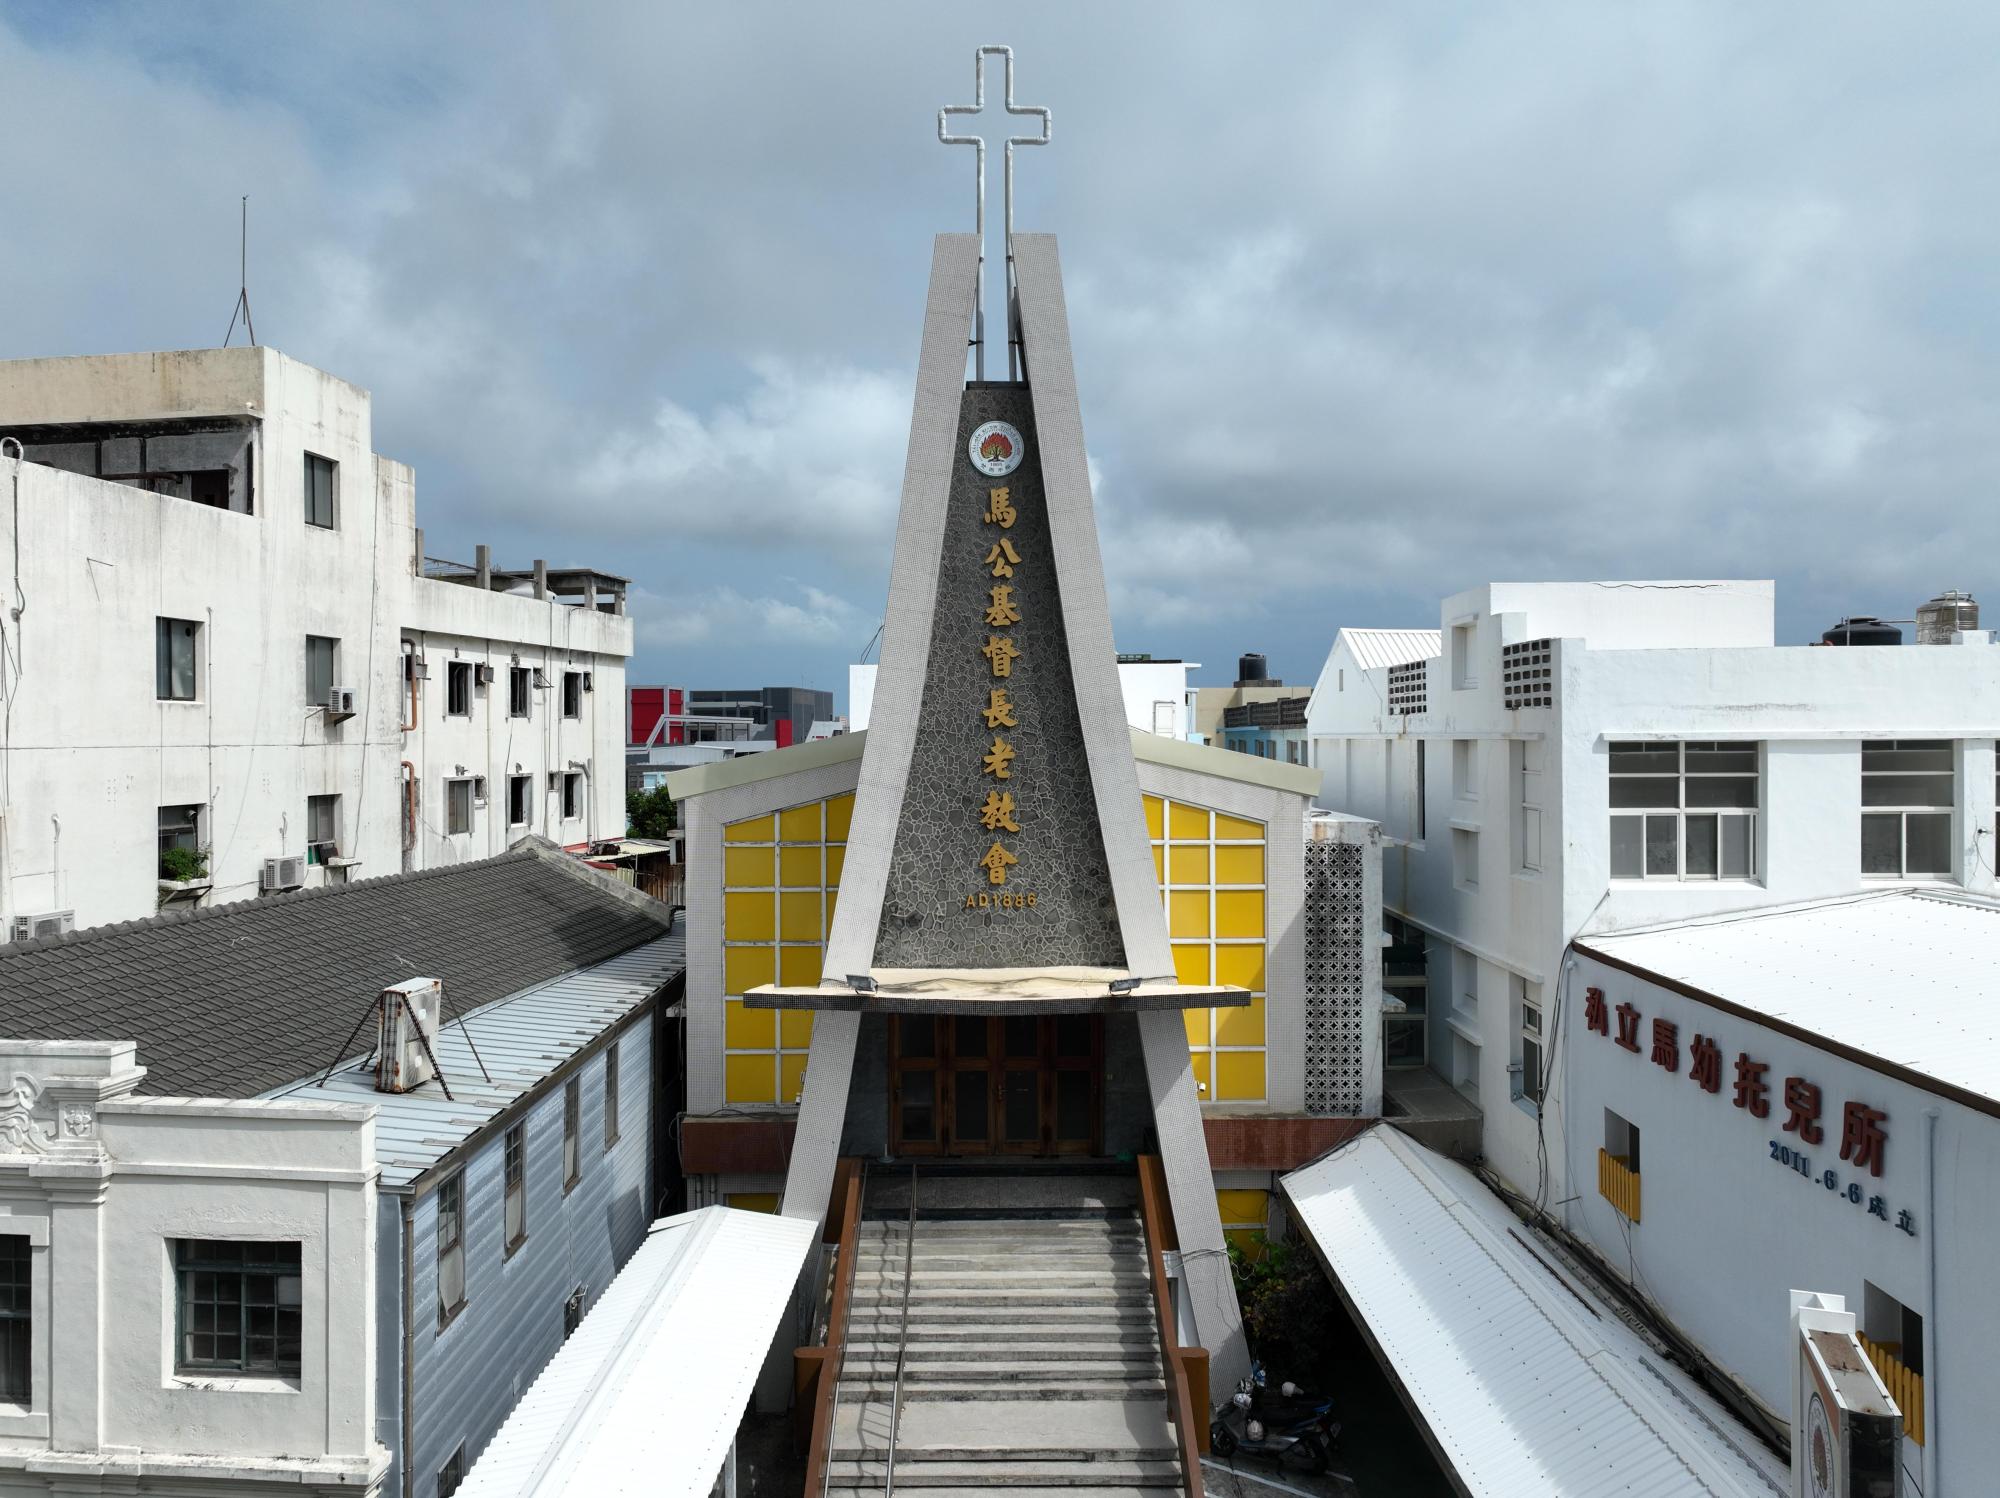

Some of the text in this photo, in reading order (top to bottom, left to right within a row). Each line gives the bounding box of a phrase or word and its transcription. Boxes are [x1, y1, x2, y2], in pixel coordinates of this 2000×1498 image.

[978, 486, 1022, 885] 馬公基督長老教會
[965, 892, 1038, 908] AD1886
[1585, 987, 1889, 1178] 私立馬幼托兒所
